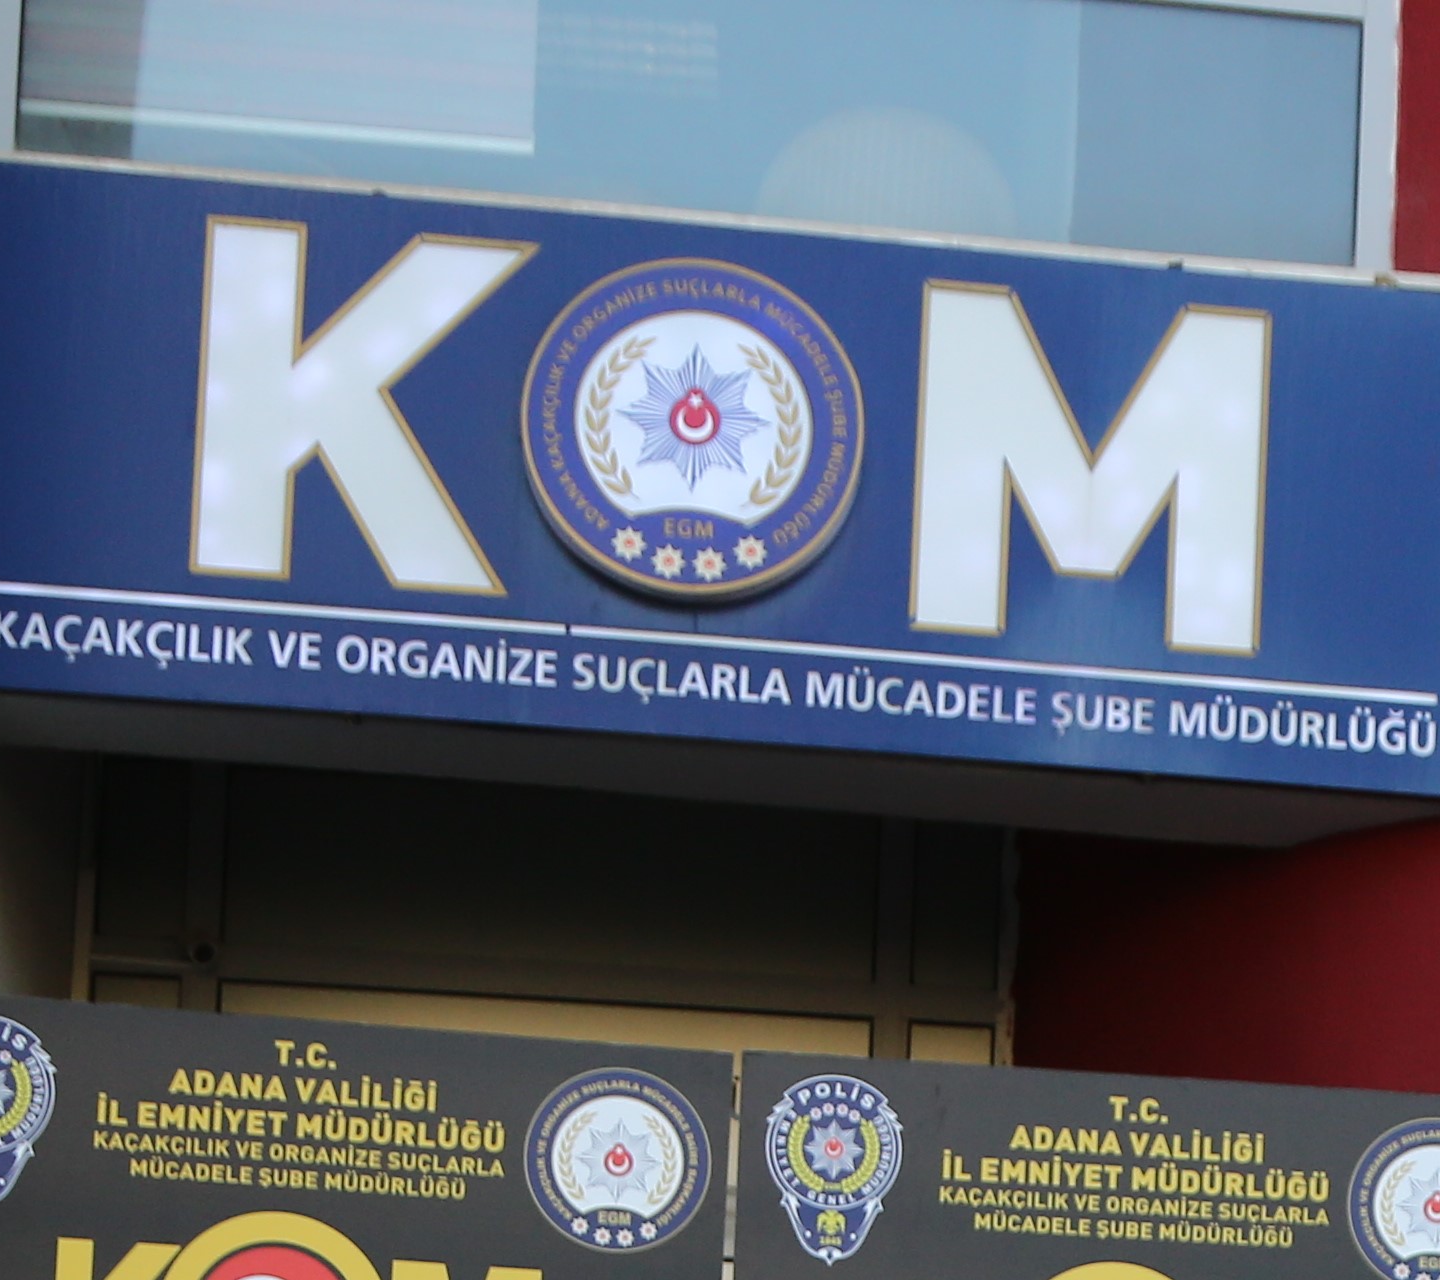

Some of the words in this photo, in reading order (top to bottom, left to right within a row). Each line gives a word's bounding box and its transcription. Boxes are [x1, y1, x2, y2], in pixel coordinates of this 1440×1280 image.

[663, 518, 715, 539] EGM
[268, 630, 323, 671] VE
[334, 634, 558, 688] ORGANİZE
[571, 652, 791, 706] SUÇLARLA
[805, 665, 1037, 726] MÜCADELE
[1050, 689, 1156, 739] ŞUBE
[1168, 693, 1438, 758] MÜDÜRLÜĞÜ
[274, 1038, 337, 1070] T.C.
[169, 1068, 288, 1102] ADANA
[295, 1075, 438, 1113] VALİLİĞİ
[797, 1082, 876, 1110] POLİS
[1109, 1096, 1169, 1124] T.C.
[96, 1092, 129, 1127] İL
[137, 1099, 289, 1138] EMNİYET
[296, 1109, 507, 1153] MÜDÜRLÜĞÜ
[93, 1130, 232, 1160] KAÇAKÇILIK
[236, 1140, 263, 1161] VE
[269, 1143, 382, 1169] ORGANİZE
[387, 1151, 506, 1179] SUÇLARLA
[1009, 1124, 1123, 1157] ADANA
[1129, 1129, 1265, 1164] VALİLİĞİ
[129, 1156, 253, 1185] MÜCADELE
[258, 1166, 318, 1190] ŞUBE
[324, 1171, 467, 1201] MÜDÜRLÜĞÜ
[941, 1149, 972, 1181] İL
[980, 1155, 1123, 1190] EMNİYET
[1131, 1163, 1331, 1203] MÜDÜRLÜĞÜ
[597, 1210, 632, 1226] EGM
[939, 1185, 1068, 1212] KAÇAKÇILIK
[1074, 1195, 1101, 1213] VE
[1106, 1196, 1213, 1220] ORGANİZE
[1219, 1203, 1330, 1226] SUÇLARLA
[974, 1212, 1091, 1237] MÜCADELE
[1096, 1220, 1153, 1240] ŞUBE
[1159, 1222, 1294, 1249] MÜDÜRLÜĞÜ
